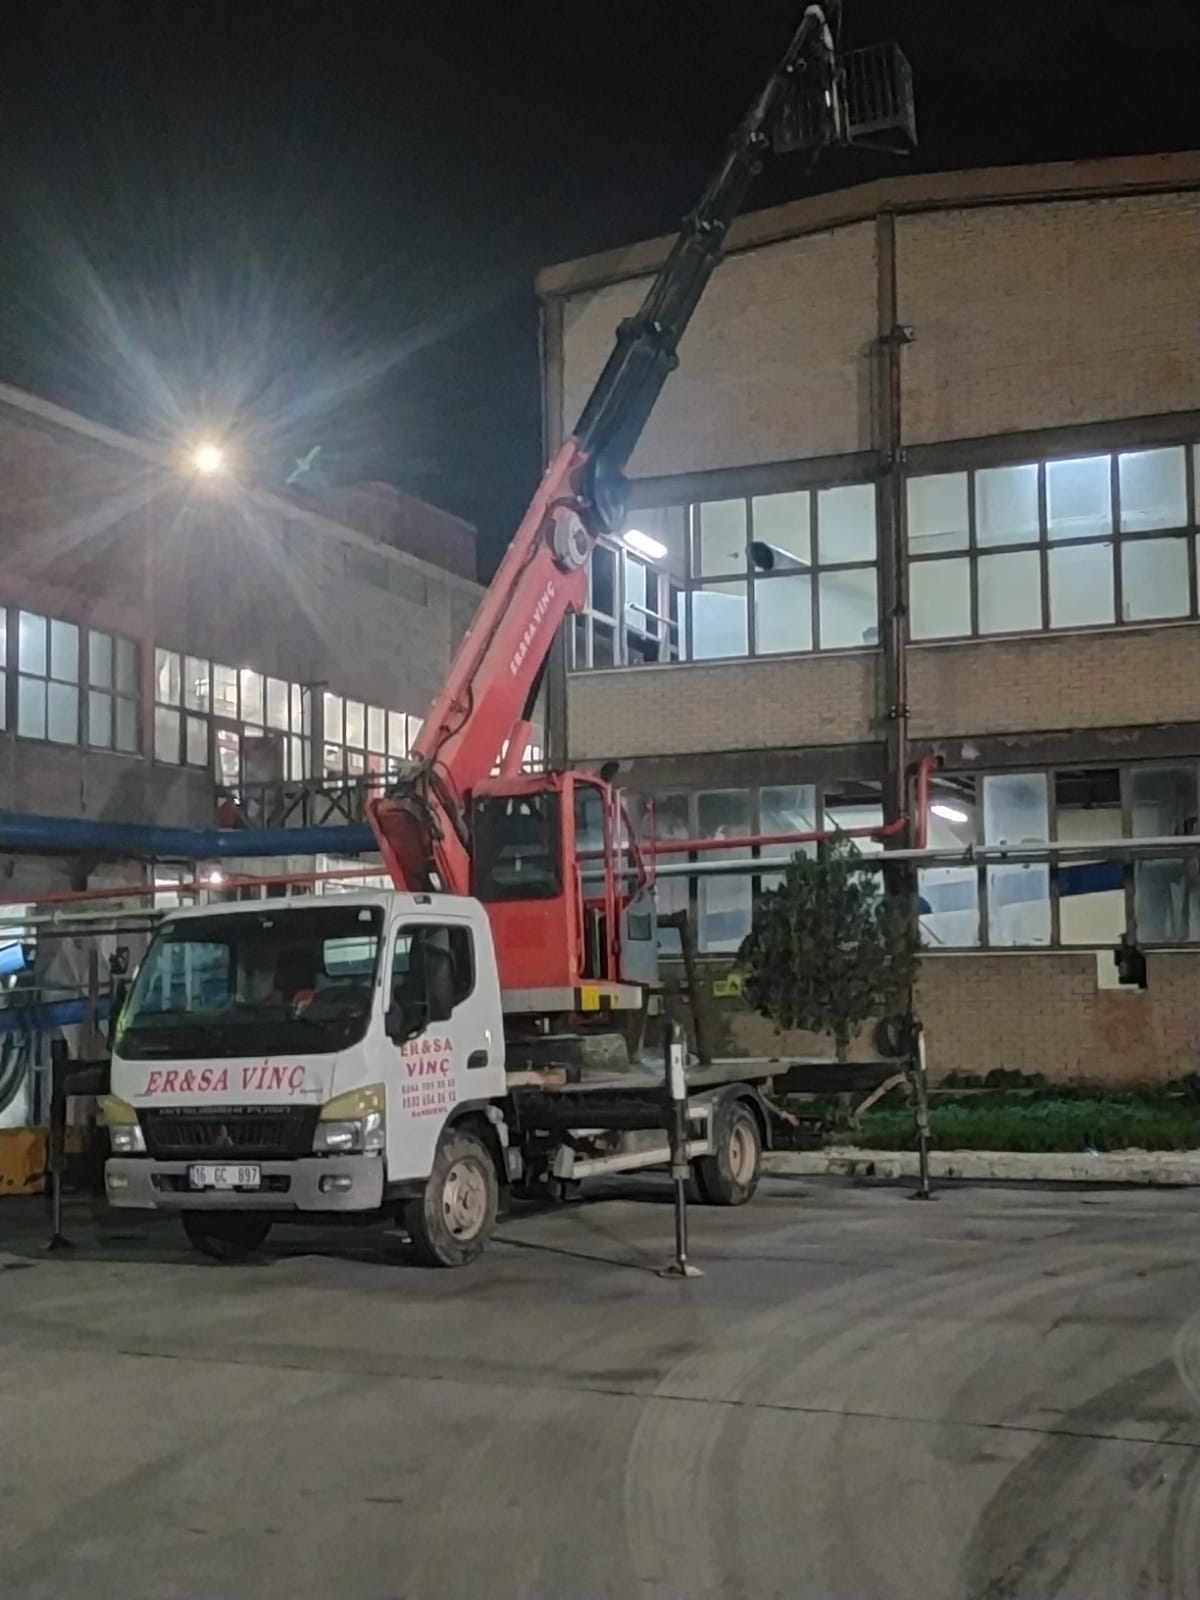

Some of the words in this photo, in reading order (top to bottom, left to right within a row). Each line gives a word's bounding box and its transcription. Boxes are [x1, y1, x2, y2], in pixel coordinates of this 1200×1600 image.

[400, 1038, 453, 1057] ER&SA
[405, 1057, 450, 1077] VİNÇ
[146, 1067, 229, 1095] ER&SA
[241, 1059, 306, 1096] VİNÇ
[195, 1167, 206, 1182] 16
[214, 1167, 227, 1183] GC
[238, 1167, 257, 1183] 897
